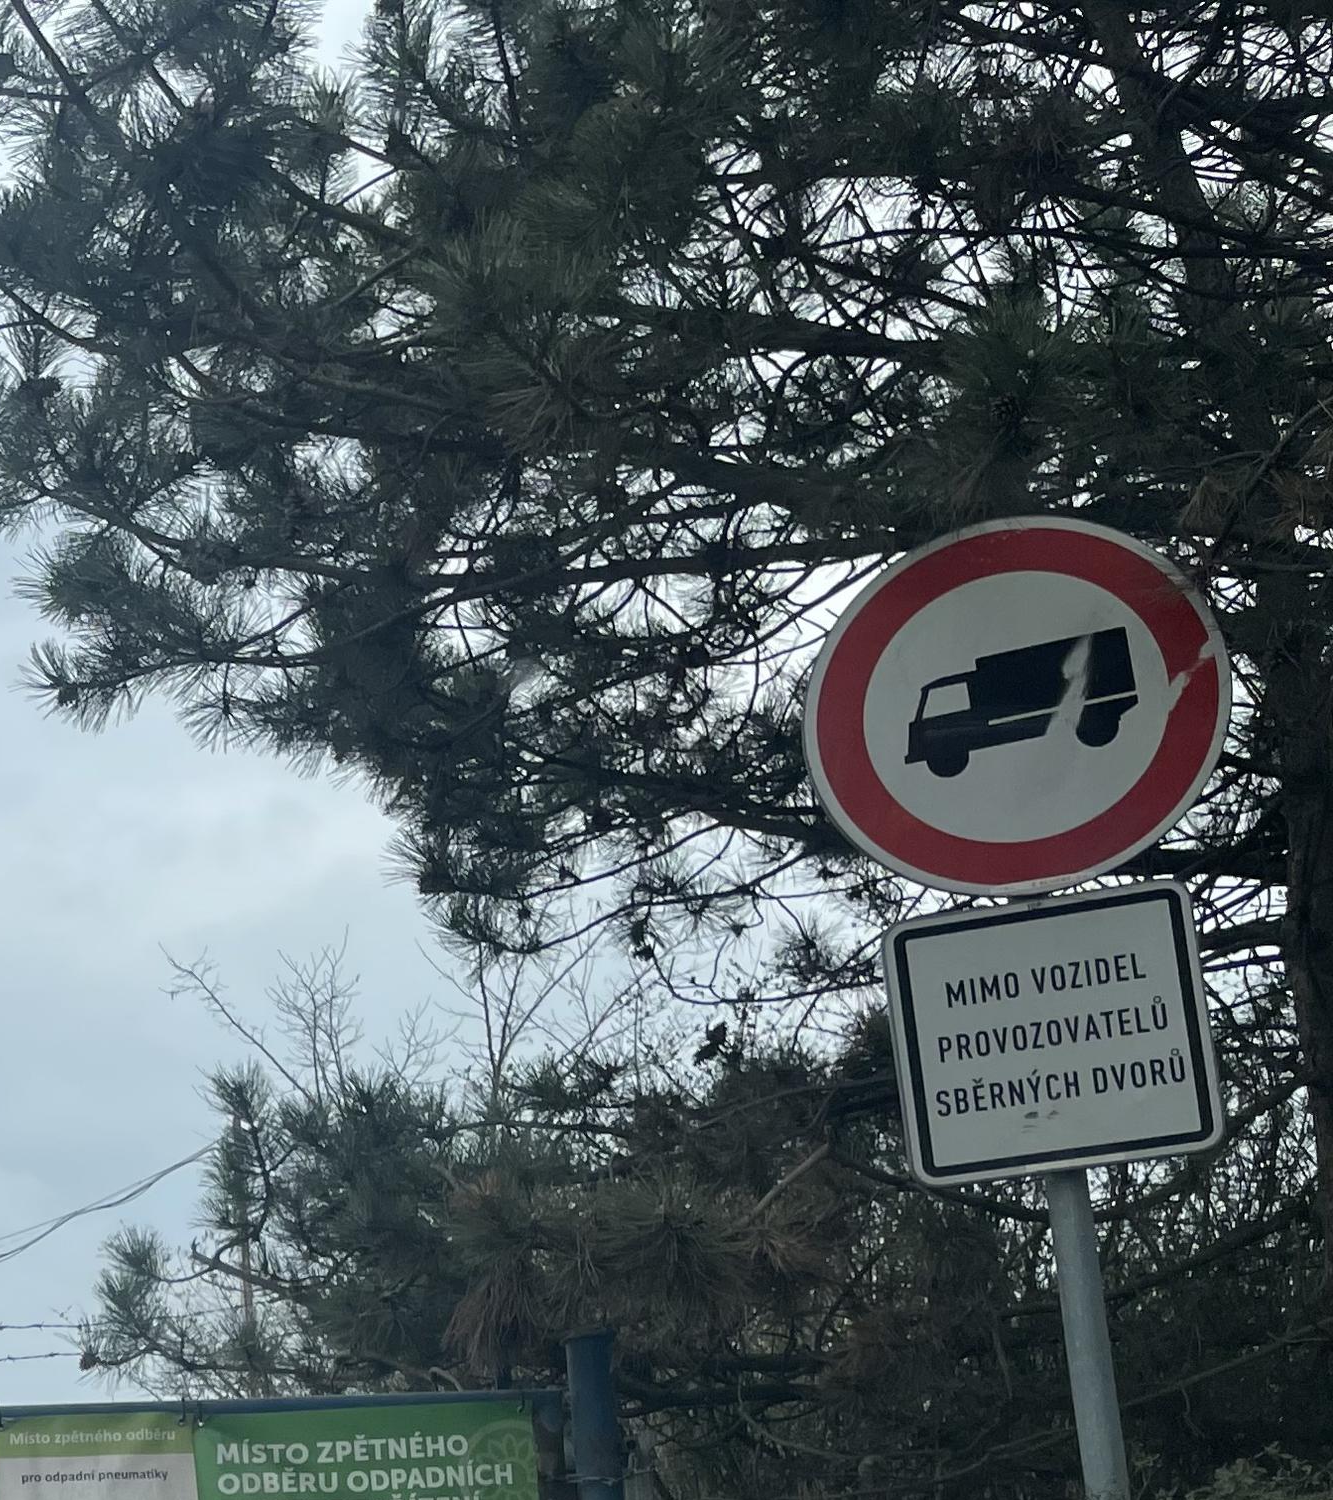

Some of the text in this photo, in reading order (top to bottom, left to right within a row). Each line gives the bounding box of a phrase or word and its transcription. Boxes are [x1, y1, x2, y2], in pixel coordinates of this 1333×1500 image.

[945, 953, 1147, 1008] MIMO VOZIDEL
[937, 995, 1168, 1063] PROVOZOVATELŮ
[936, 1048, 1186, 1117] SBĚRNÝCH DVORŮ
[9, 1428, 176, 1445] Místo zpětného odběru
[216, 1431, 469, 1465] MÍSTO ZPĚTNÉHO
[21, 1469, 168, 1484] pro odpadní pneumatiky
[217, 1459, 513, 1495] ODBĚRU ODPADNÍCH
